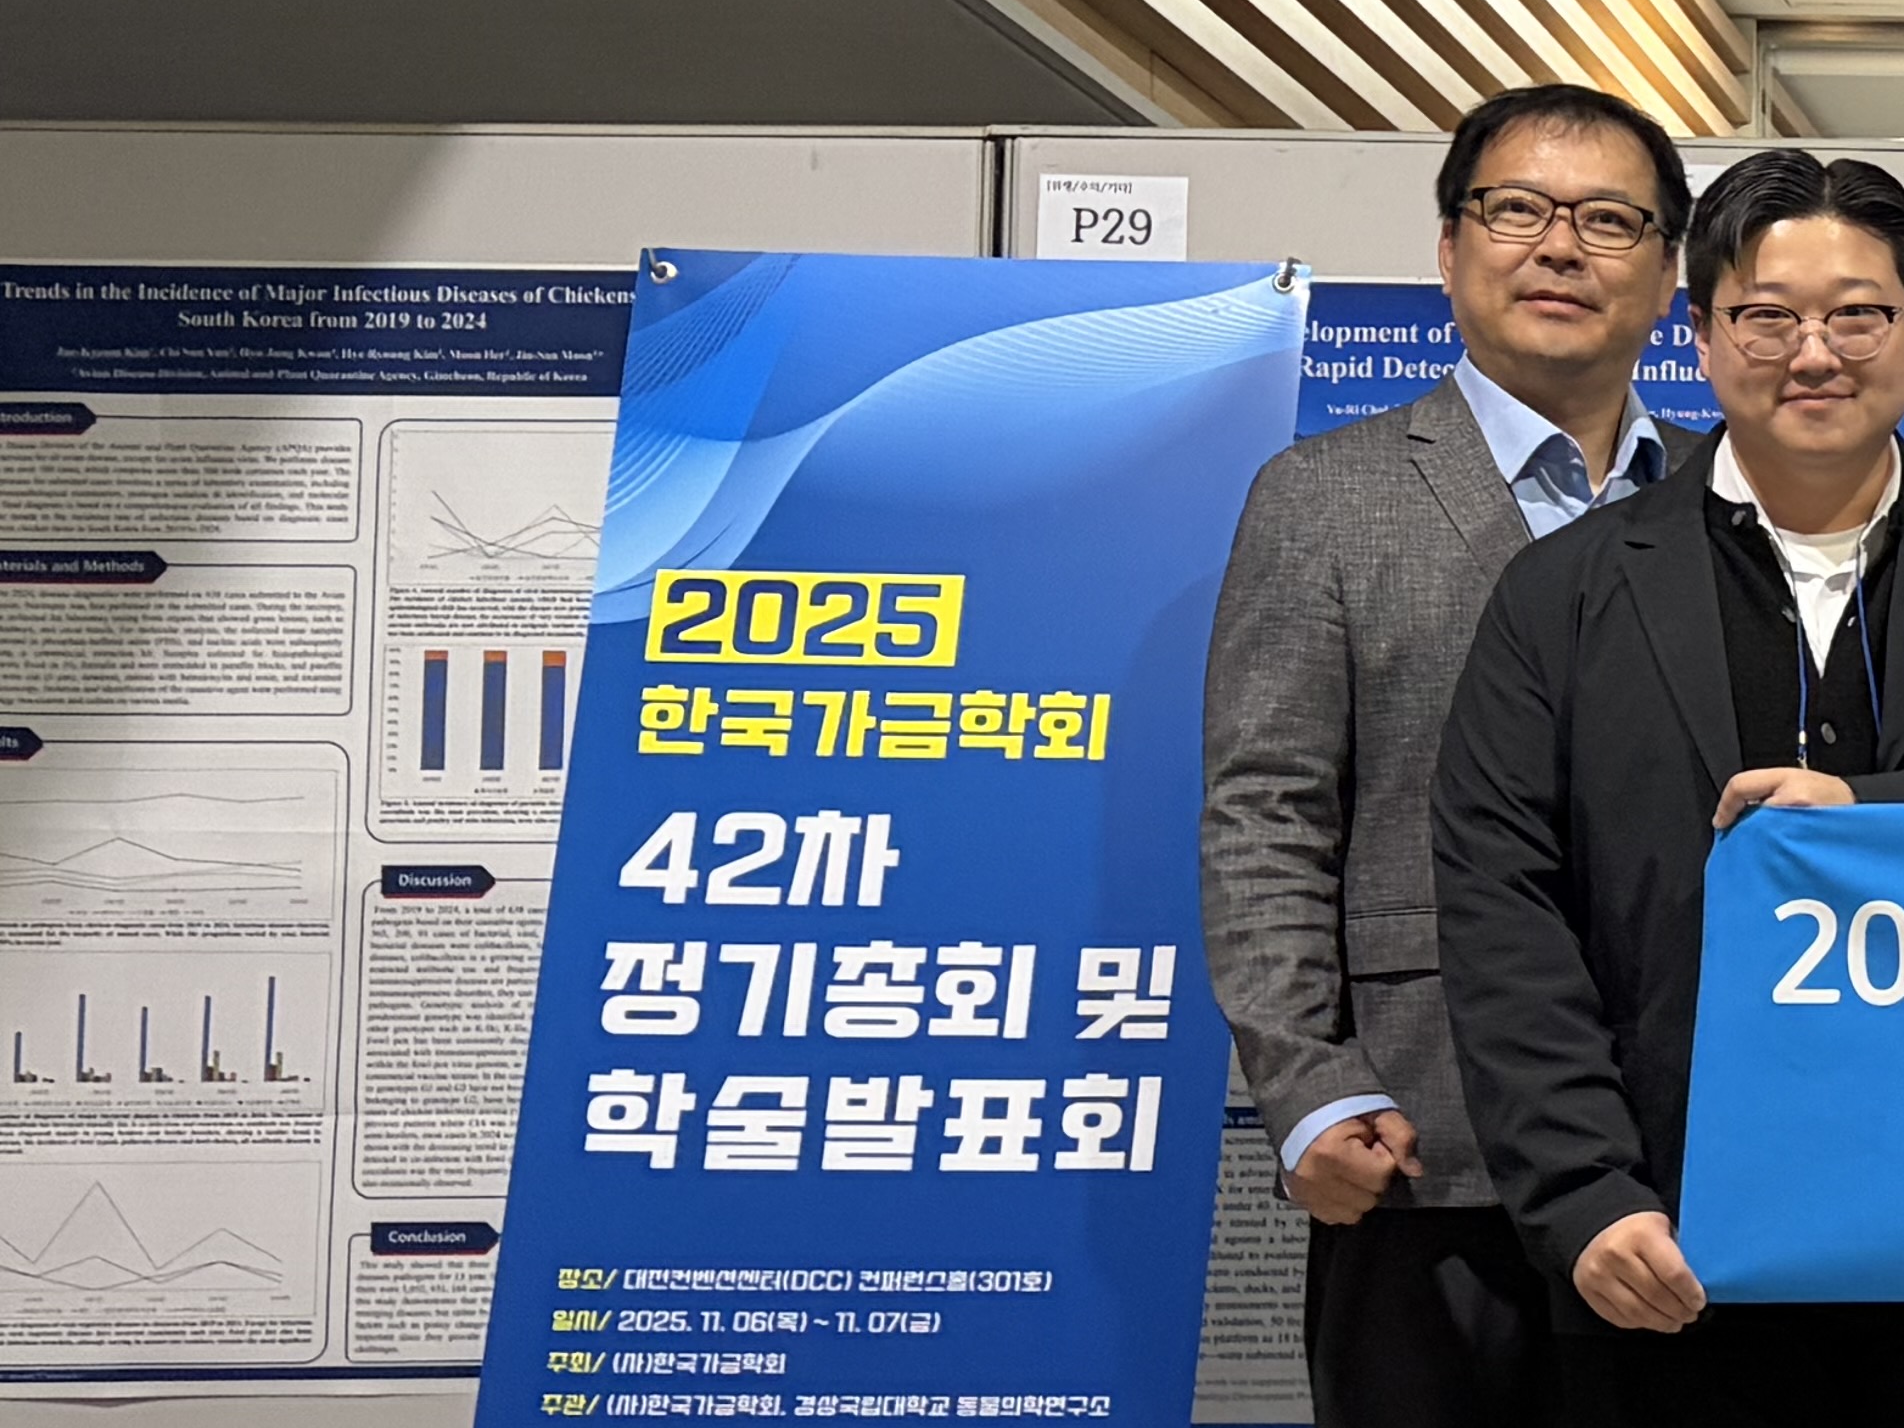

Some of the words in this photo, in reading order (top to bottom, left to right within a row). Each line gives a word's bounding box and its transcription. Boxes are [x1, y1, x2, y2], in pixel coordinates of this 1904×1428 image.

[1070, 207, 1153, 246] P29
[2, 281, 70, 300] Trends
[75, 283, 95, 300] in
[100, 282, 132, 301] the
[137, 283, 233, 301] Incidence
[238, 284, 260, 301] of
[265, 284, 328, 306] Major
[332, 285, 432, 304] Infectious
[436, 285, 518, 304] Diseases
[522, 286, 544, 304] of
[177, 310, 236, 328] South
[242, 310, 304, 328] Korea
[308, 310, 358, 329] from
[363, 311, 411, 329] 2019
[415, 312, 436, 330] to
[440, 311, 488, 330] 2024
[1303, 320, 1420, 349] elopment
[1426, 321, 1457, 344] of
[1301, 356, 1374, 385] Rapid
[1383, 356, 1455, 379] Detec
[0, 411, 73, 424] troduction
[0, 559, 47, 573] terials
[51, 559, 79, 573] and
[83, 559, 146, 573] Methods
[660, 577, 942, 659] 2025
[638, 683, 1111, 760] 한국가금학회
[618, 808, 900, 908] 42차
[397, 872, 473, 888] Discussion
[599, 939, 1037, 1040] 정기총회
[1075, 944, 1177, 1040] 및
[583, 1068, 1162, 1173] 학술발표회
[387, 1229, 468, 1244] Conclusion
[556, 1267, 618, 1291] 장소/
[622, 1268, 854, 1293] 대전컨벤션센터(DCC)
[551, 1309, 612, 1334] 일시/
[616, 1309, 694, 1334] 2025.
[701, 1310, 727, 1334] 11.
[731, 1310, 809, 1335] 06(목)
[835, 1310, 862, 1334] 11.
[867, 1310, 943, 1335] 07(금)
[611, 1351, 787, 1376] (사)한국가금학회
[540, 1393, 601, 1418] 주관/
[794, 1394, 950, 1418] 경상국립대학교
[956, 1395, 1111, 1419] 동물의학연구소
